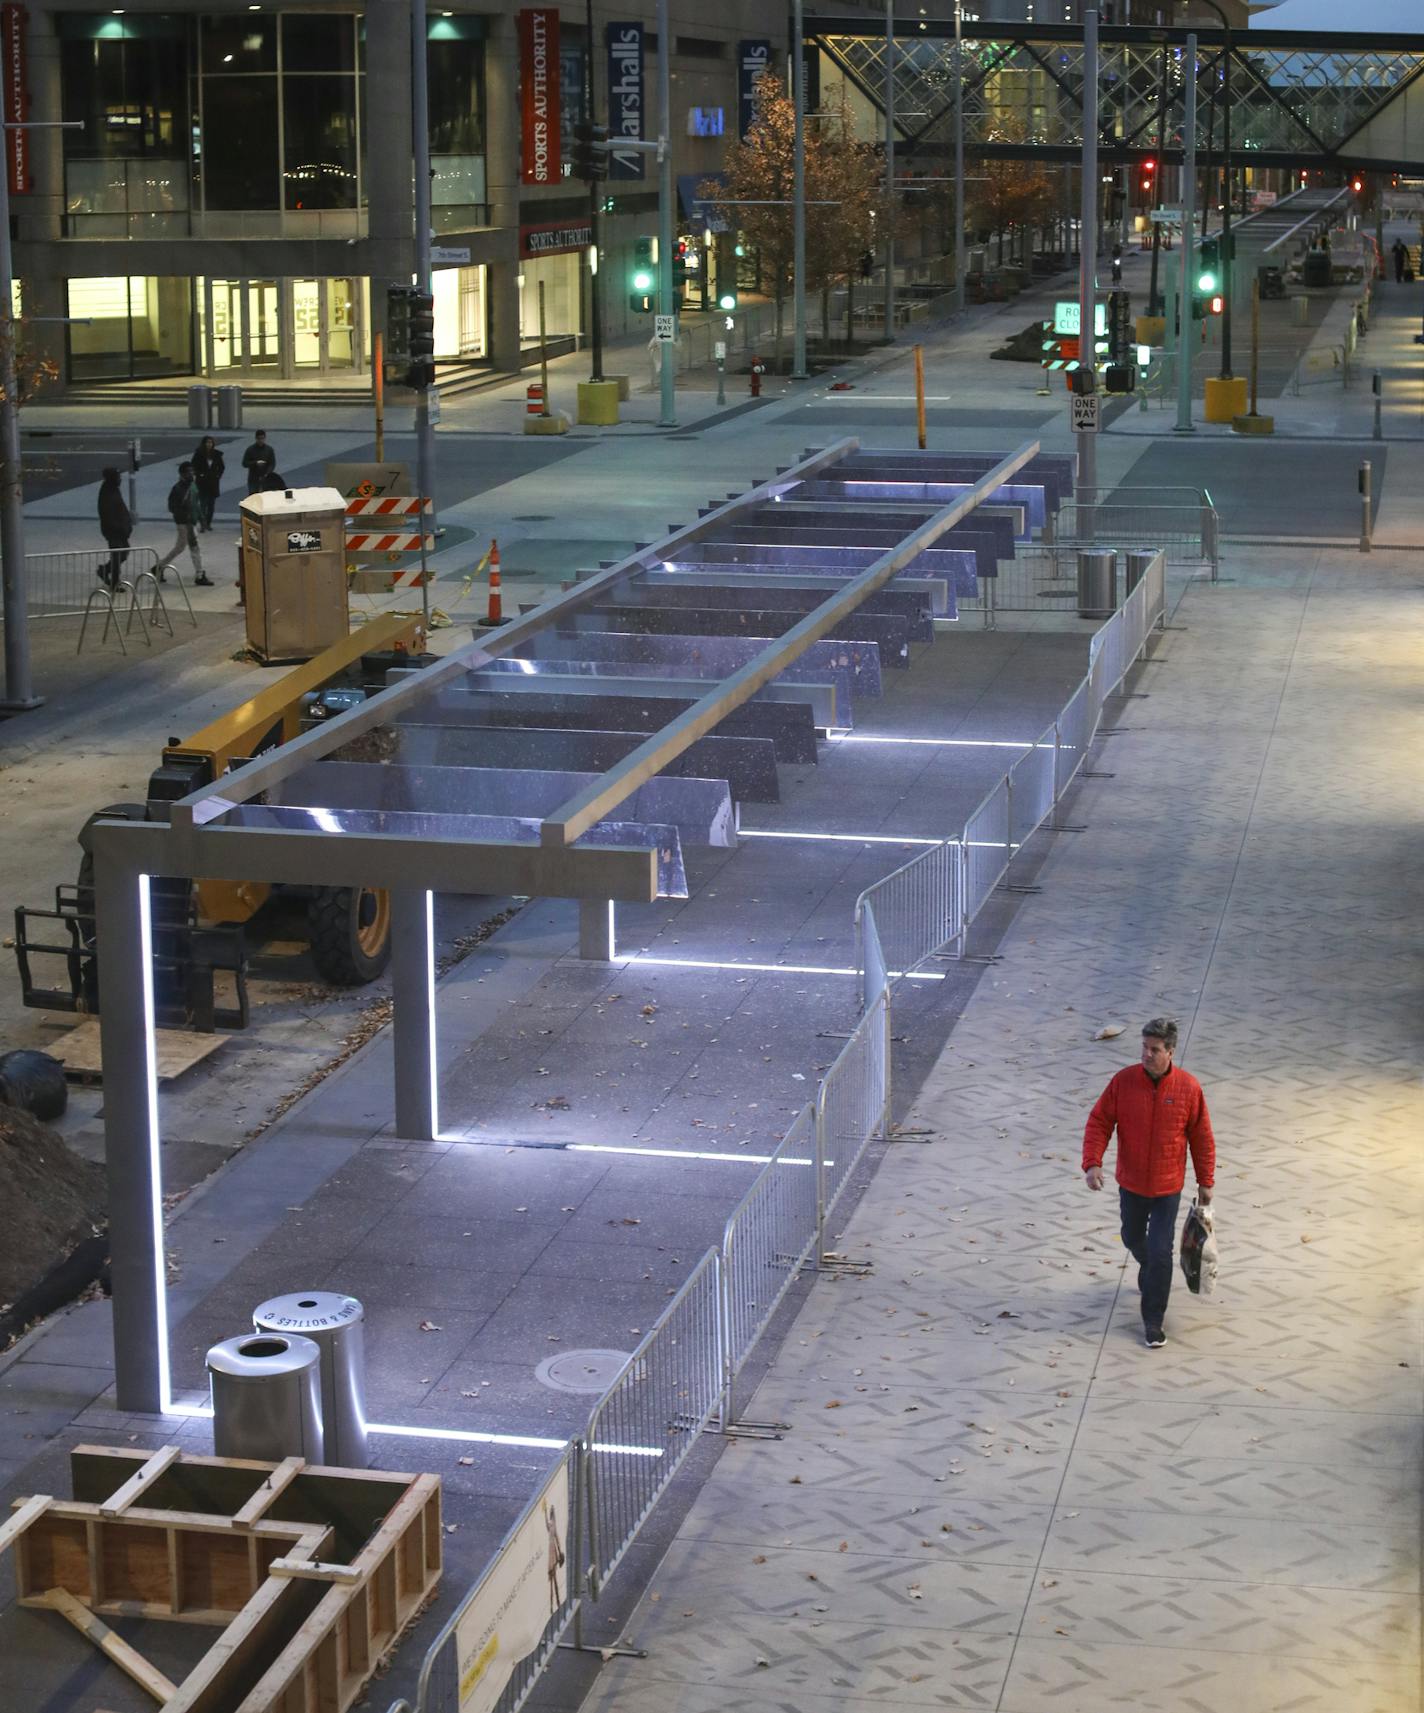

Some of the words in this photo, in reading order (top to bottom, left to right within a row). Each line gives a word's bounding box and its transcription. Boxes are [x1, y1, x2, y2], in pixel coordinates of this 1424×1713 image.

[533, 13, 547, 119] AUTHORITY
[612, 29, 641, 173] Marshalls
[535, 122, 548, 181] SPORTS
[530, 231, 554, 251] SPORTS
[1066, 308, 1080, 317] RO
[1060, 320, 1080, 329] CLO
[1075, 399, 1096, 408] ONE
[1074, 409, 1096, 418] WAY
[388, 471, 400, 489] 7
[277, 1317, 328, 1327] BOTTLES
